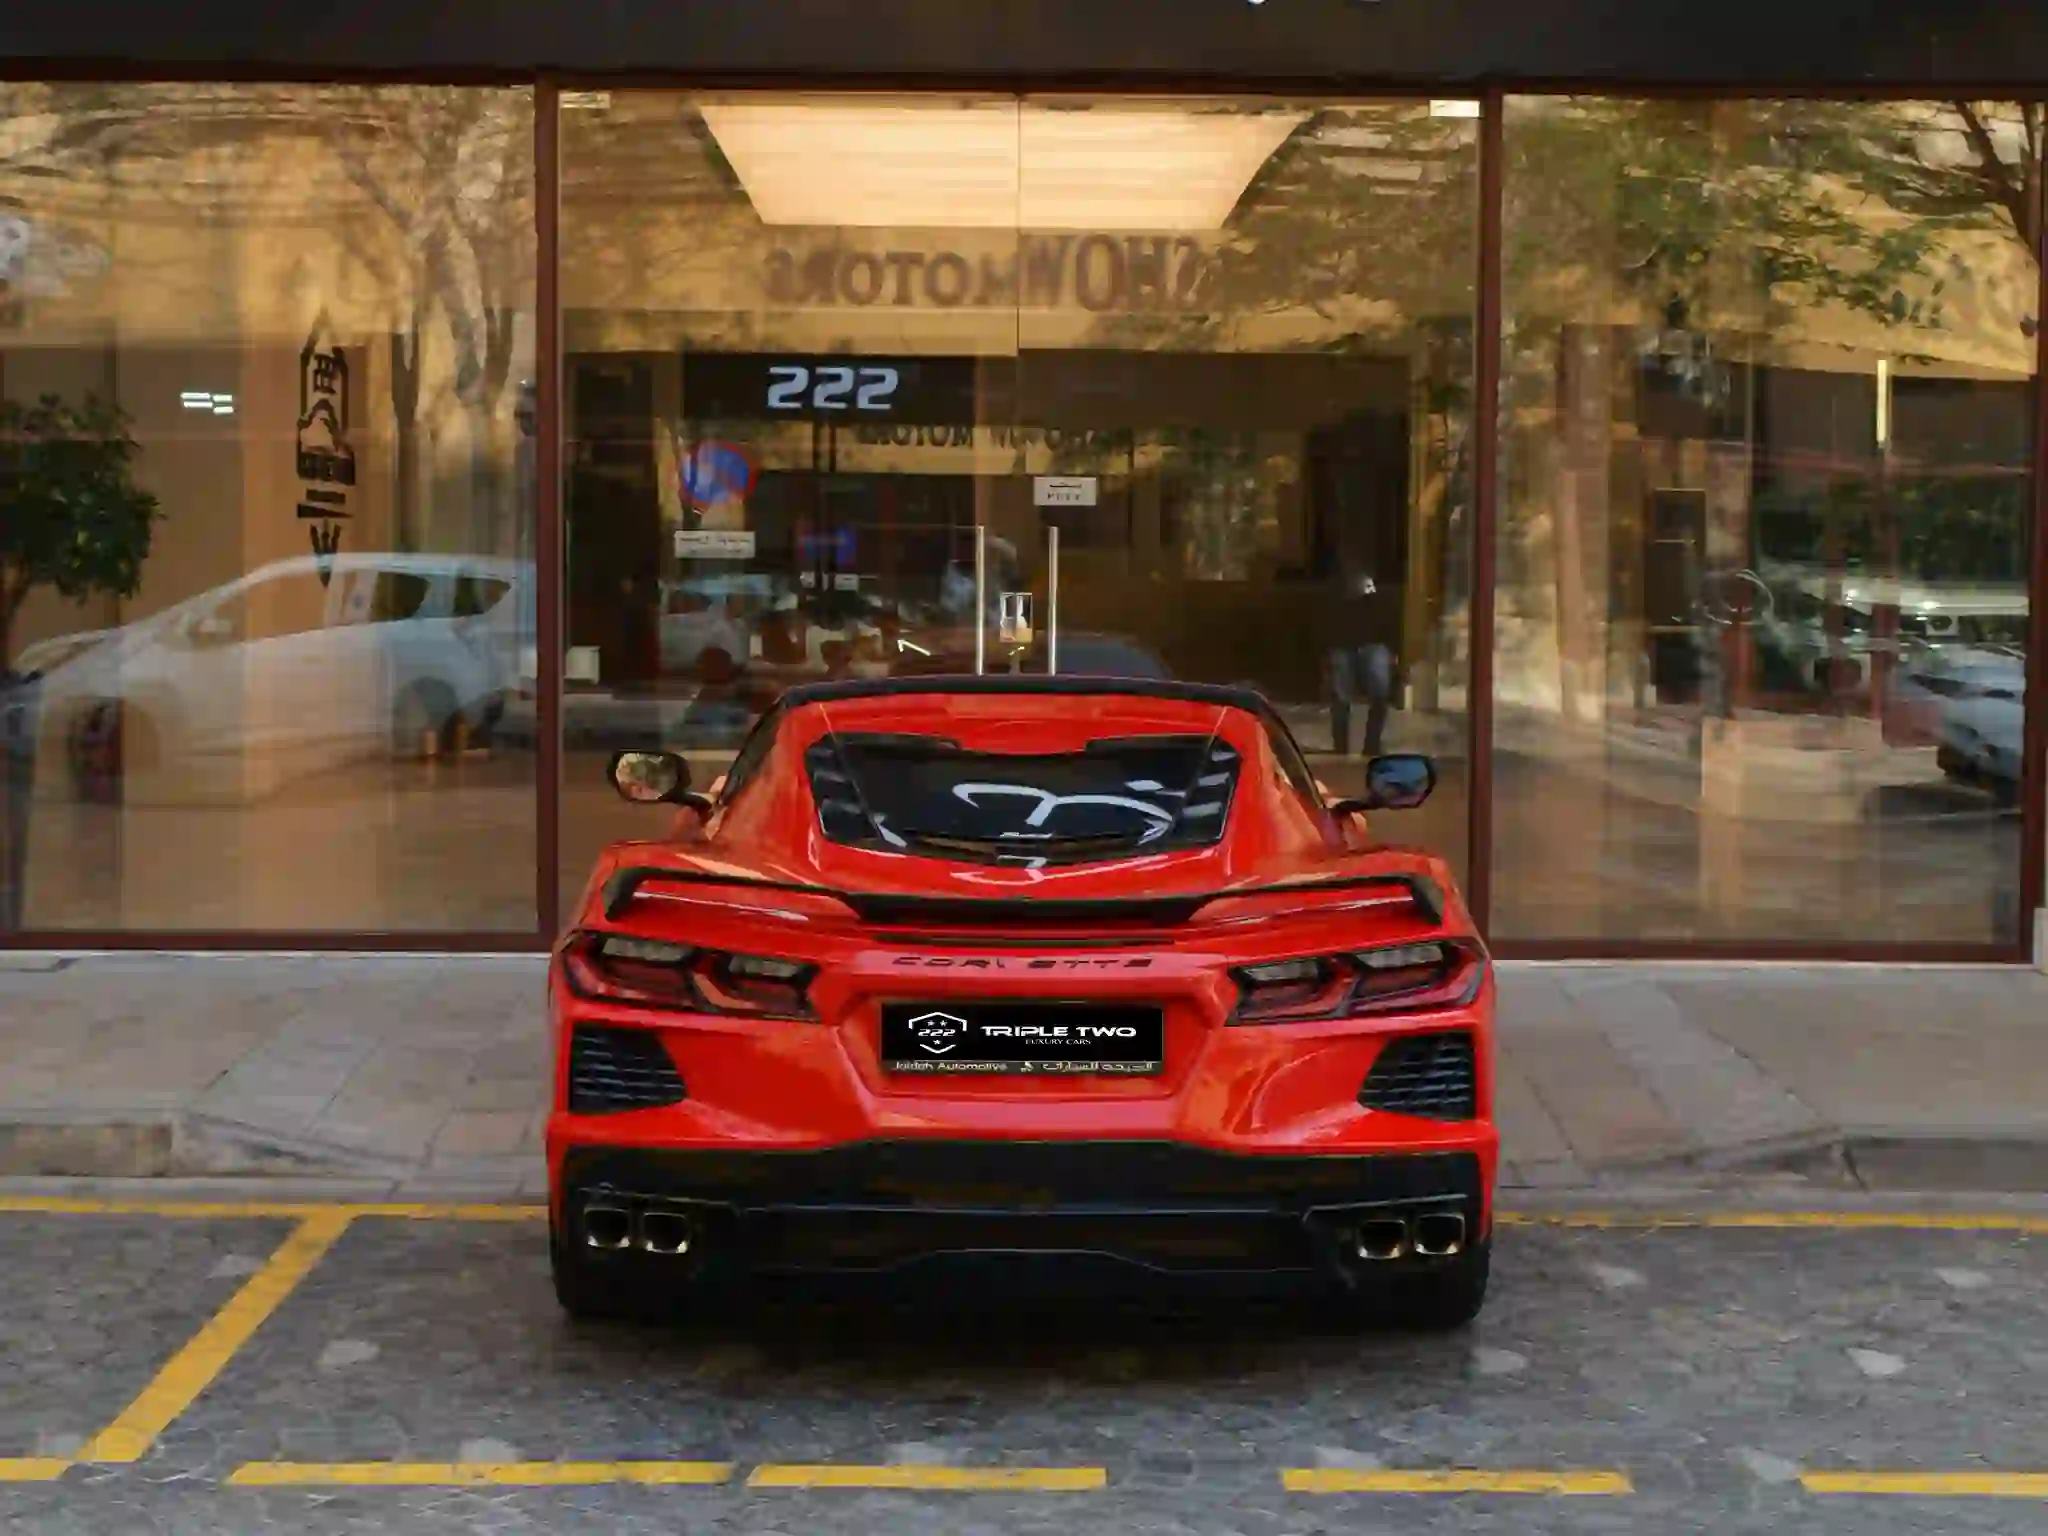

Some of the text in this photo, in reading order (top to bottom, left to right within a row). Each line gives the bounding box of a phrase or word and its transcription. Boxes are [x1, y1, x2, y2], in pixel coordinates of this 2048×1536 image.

[767, 366, 898, 409] 222
[918, 1028, 956, 1037] 222
[980, 1025, 1137, 1037] TRIPLE TWO
[937, 1062, 1008, 1071] Automotive
